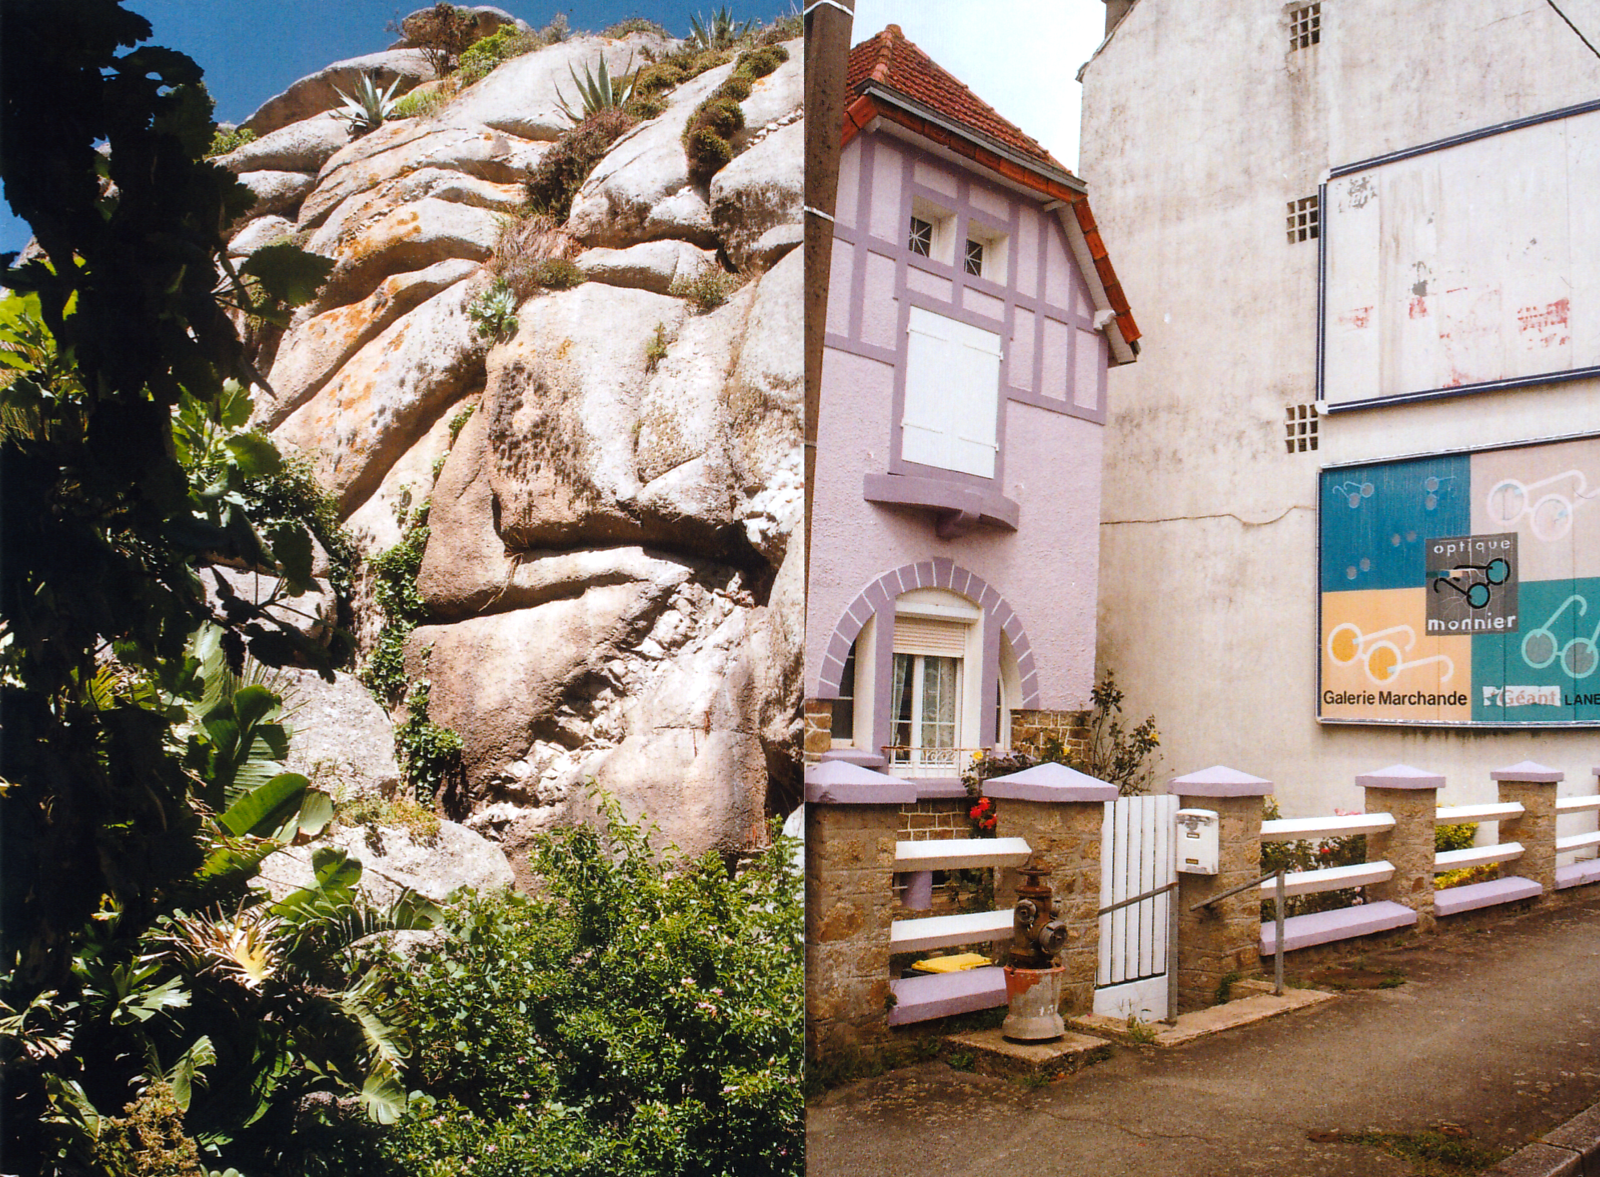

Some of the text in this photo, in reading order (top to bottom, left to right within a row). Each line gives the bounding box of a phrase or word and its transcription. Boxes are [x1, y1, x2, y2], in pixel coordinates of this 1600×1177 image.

[1433, 540, 1511, 557] optique
[1428, 612, 1516, 631] monnier
[1323, 690, 1468, 706] Galerie Marchande
[1499, 689, 1557, 705] Géant
